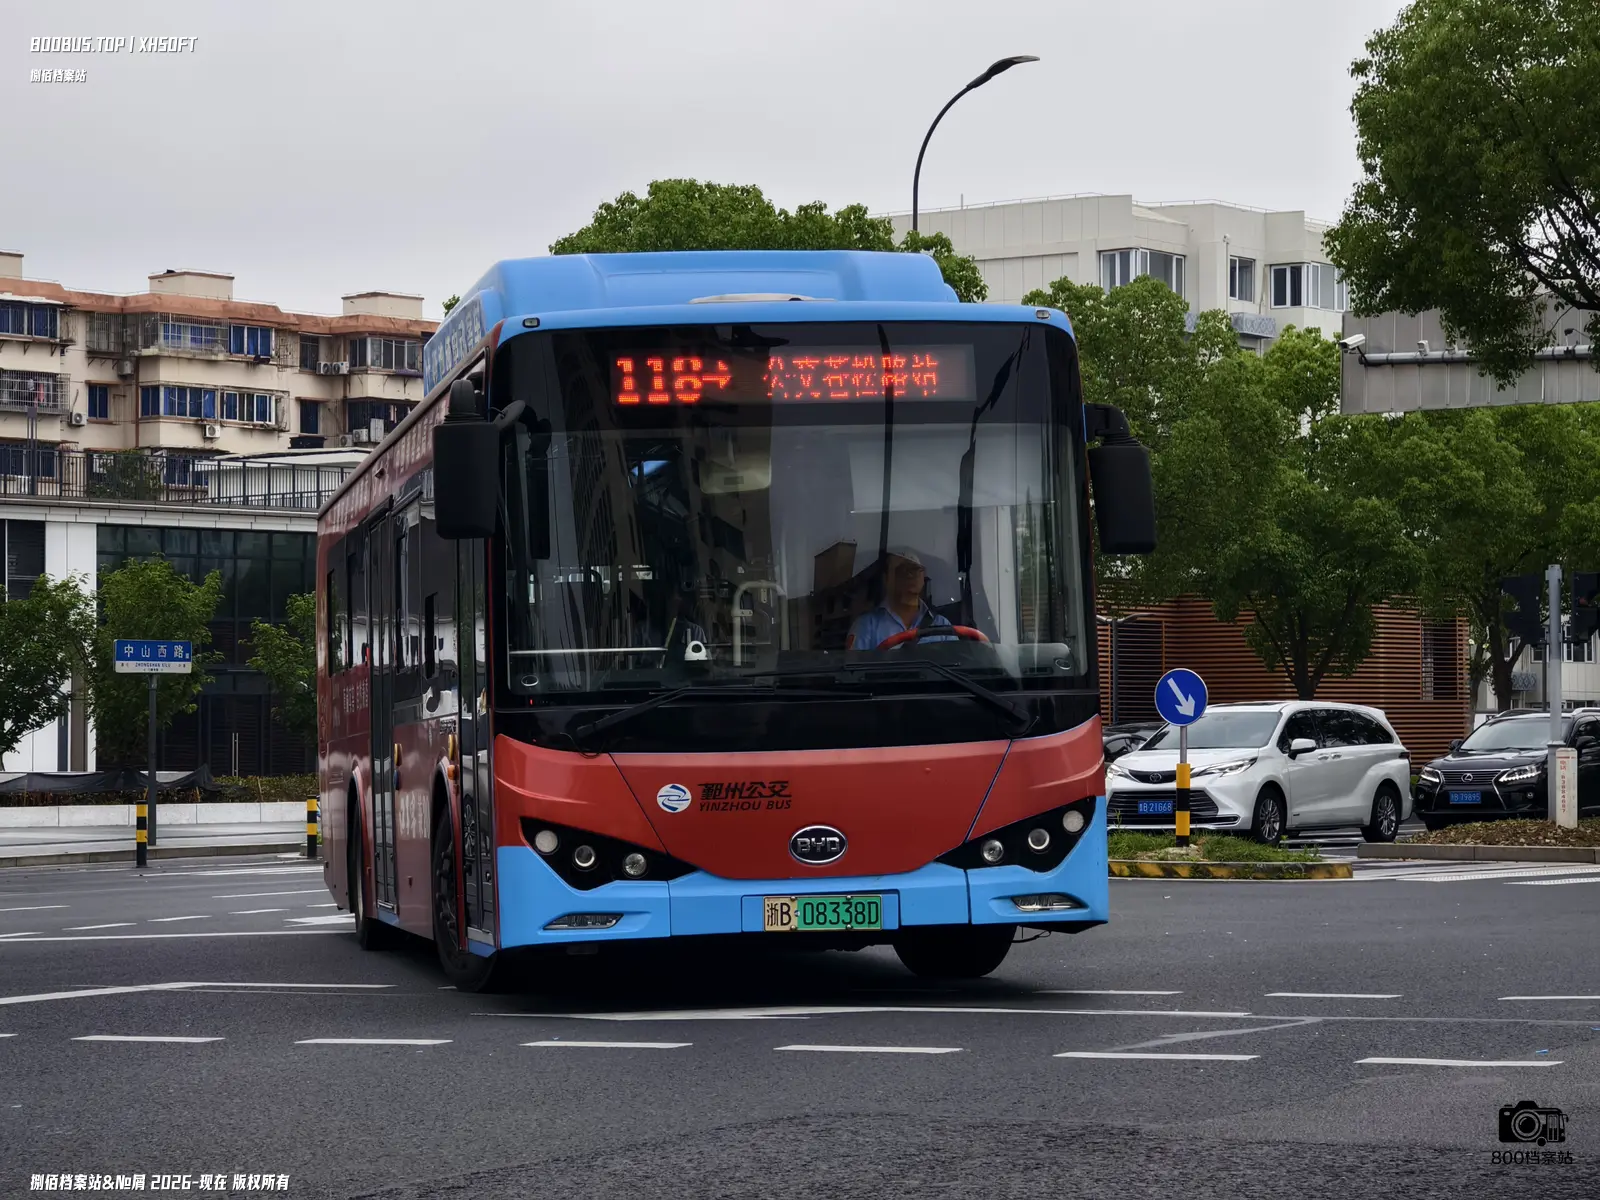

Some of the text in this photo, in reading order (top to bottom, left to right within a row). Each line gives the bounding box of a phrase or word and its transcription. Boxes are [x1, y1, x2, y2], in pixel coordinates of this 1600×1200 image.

[124, 644, 184, 659] 中山西路
[698, 781, 792, 800] 鄞州公交
[699, 800, 792, 812] YINZHOU BUS
[797, 836, 840, 854] BYD
